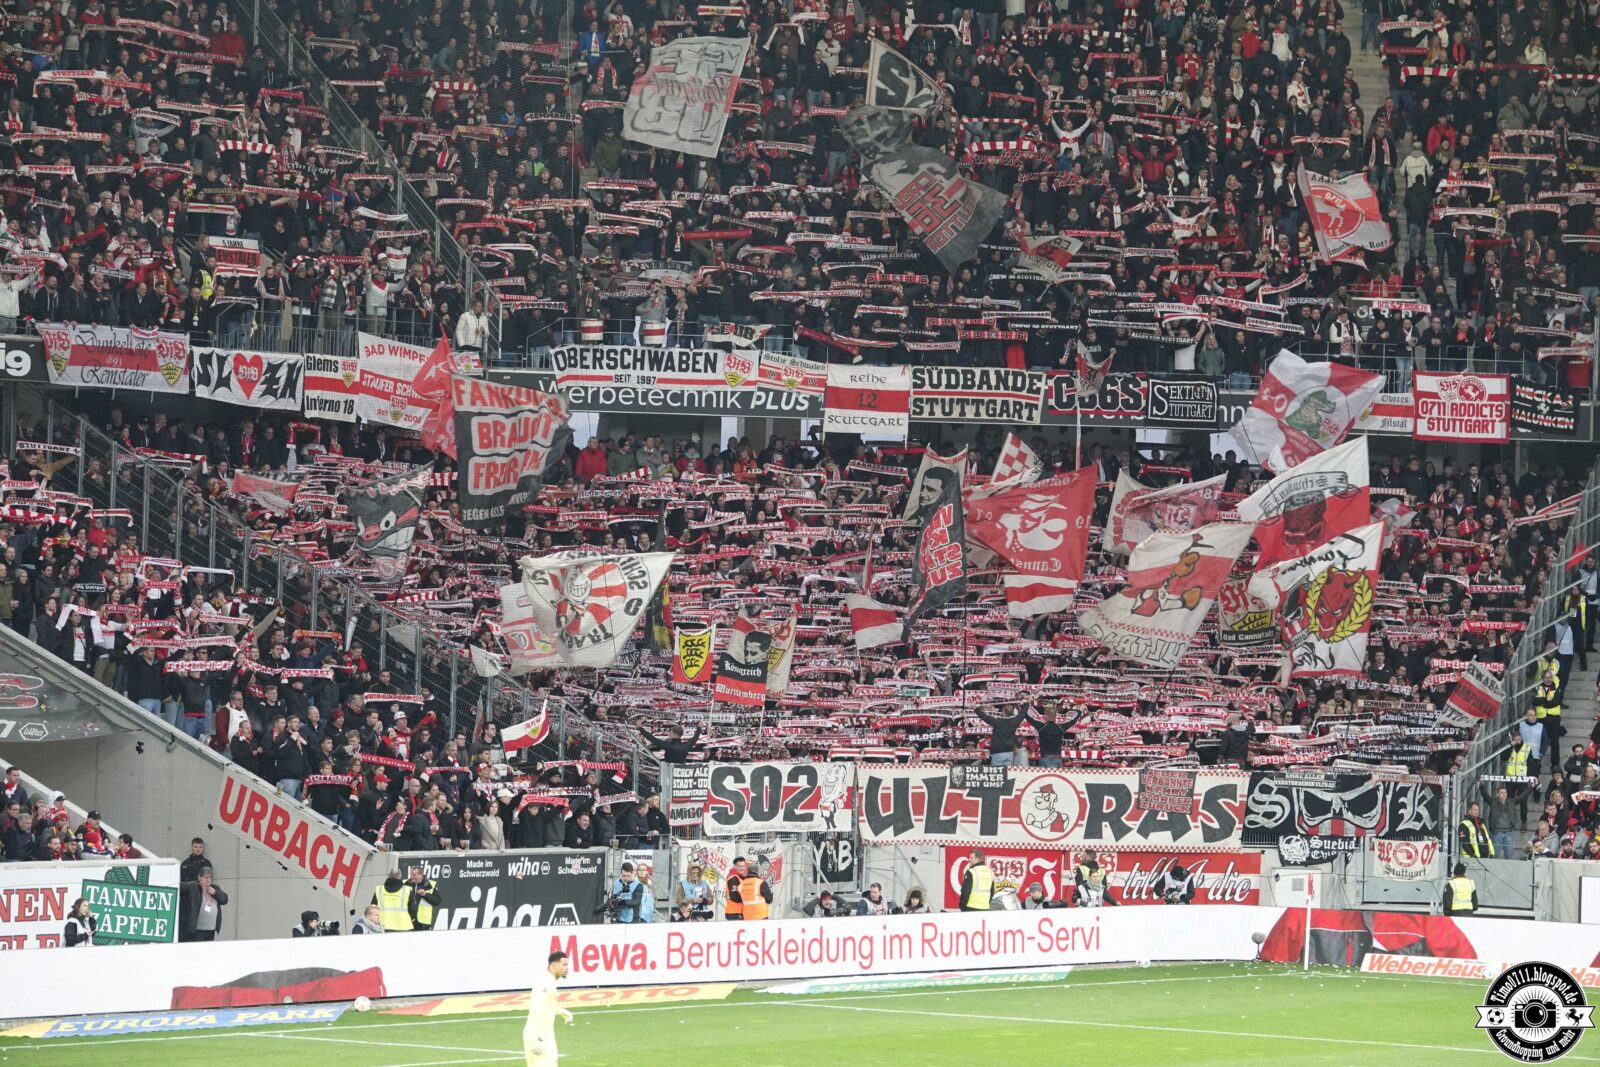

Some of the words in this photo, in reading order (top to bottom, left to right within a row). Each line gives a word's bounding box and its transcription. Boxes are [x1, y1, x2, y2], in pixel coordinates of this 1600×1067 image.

[215, 253, 257, 265] EMSTALER
[364, 343, 385, 358] BAD
[554, 346, 718, 374] OBERSCHWABEN
[305, 354, 339, 374] Glems
[361, 373, 395, 394] STAUFER
[613, 374, 632, 384] SEIT
[636, 374, 657, 386] 1997
[849, 373, 887, 384] Reihe
[912, 365, 1044, 394] SÜDBANDE
[305, 395, 341, 413] Inferno
[342, 399, 355, 415] 18
[750, 390, 810, 412] PLUS
[856, 392, 879, 408] 12
[1420, 400, 1447, 417] 0711
[1450, 402, 1504, 419] ADDICTS
[912, 398, 1040, 422] STUTTGART
[1511, 407, 1575, 430] HALUNKEN
[1426, 416, 1497, 434] STUTTGART
[724, 660, 762, 678] Königreich
[965, 766, 979, 774] DU
[982, 766, 1004, 774] BIST
[965, 773, 1004, 782] IMMER
[219, 775, 363, 898] URBACH
[1309, 836, 1356, 850] Suebia
[458, 868, 500, 879] Schwarzwald
[466, 860, 485, 869] Made
[485, 860, 493, 869] im
[507, 856, 540, 877] wiha
[1383, 863, 1426, 880] Stuttgart
[86, 884, 174, 912] TANNEN
[549, 934, 657, 974] Mewa.
[666, 925, 875, 971] Berufskleidung
[882, 925, 912, 960] im
[921, 915, 1101, 959] Rundum-Servi
[54, 1011, 218, 1034] EUROPA
[229, 1005, 341, 1024] PARK
